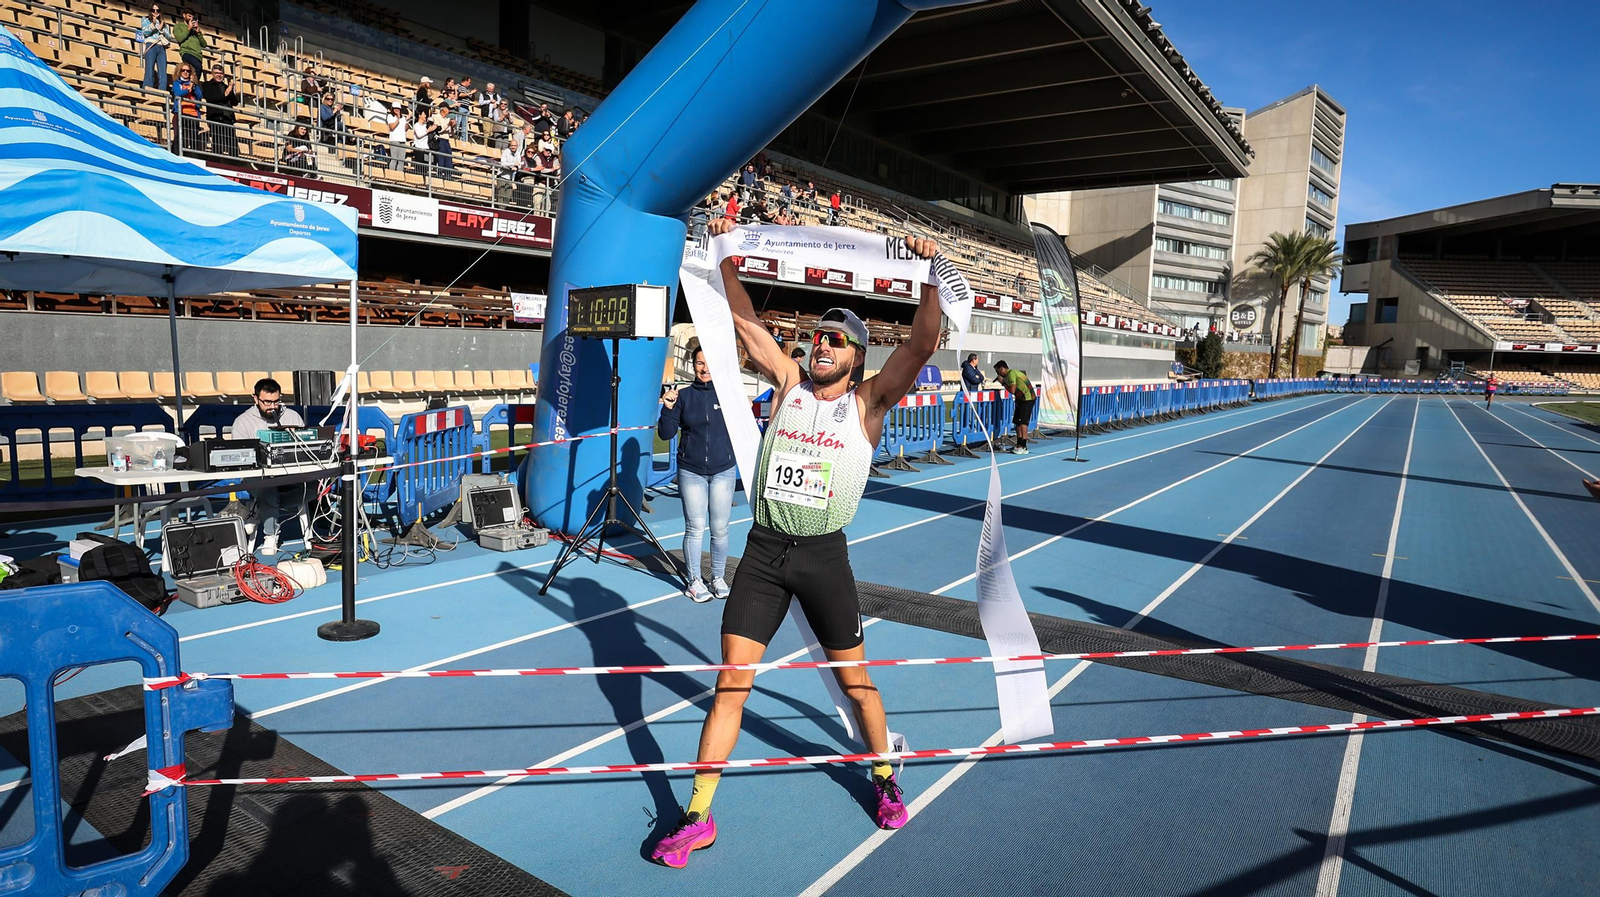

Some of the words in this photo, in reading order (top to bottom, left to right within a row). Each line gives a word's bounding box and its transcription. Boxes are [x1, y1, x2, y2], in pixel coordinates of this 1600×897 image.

[395, 206, 433, 218] Ayuntamiento
[270, 219, 308, 230] Ayuntamiento
[308, 223, 316, 231] de
[446, 211, 489, 229] PLAY
[289, 229, 311, 237] Deportes
[762, 247, 794, 255] Deportes
[764, 239, 822, 249] Ayuntamiento
[823, 240, 833, 249] de
[835, 241, 856, 251] Jerez
[689, 249, 709, 262] JEREZ
[807, 268, 827, 278] PLAY
[875, 278, 892, 288] PLAY
[577, 297, 628, 325] 1:10:08
[1232, 311, 1256, 321] B&B
[775, 428, 844, 450] maratón
[788, 446, 821, 457] JEREZ
[775, 465, 804, 487] 193
